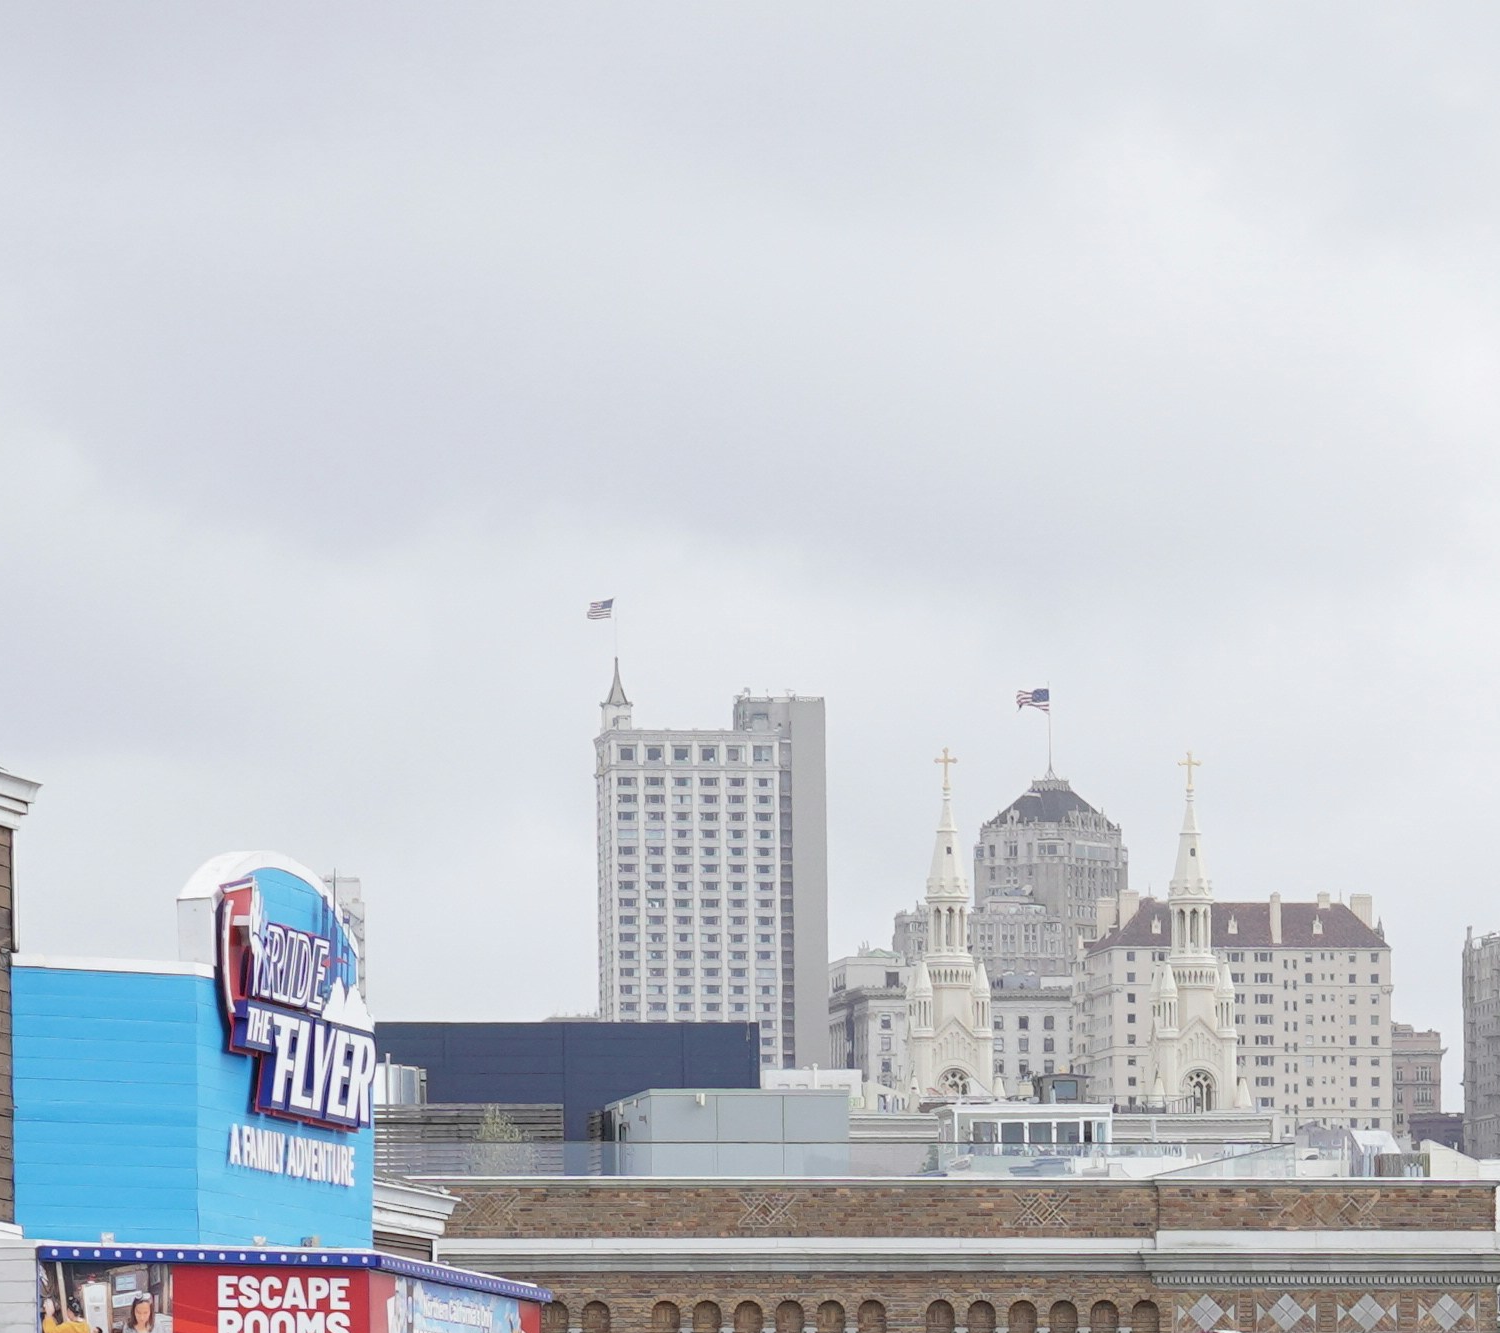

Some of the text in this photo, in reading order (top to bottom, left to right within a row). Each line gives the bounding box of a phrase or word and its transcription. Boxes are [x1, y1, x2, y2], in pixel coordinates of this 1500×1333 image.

[248, 1006, 273, 1045] THE
[272, 1014, 377, 1129] FLYER
[230, 1124, 356, 1187] A FAMILY ADVENTURE
[217, 1275, 350, 1310] ESCAPE
